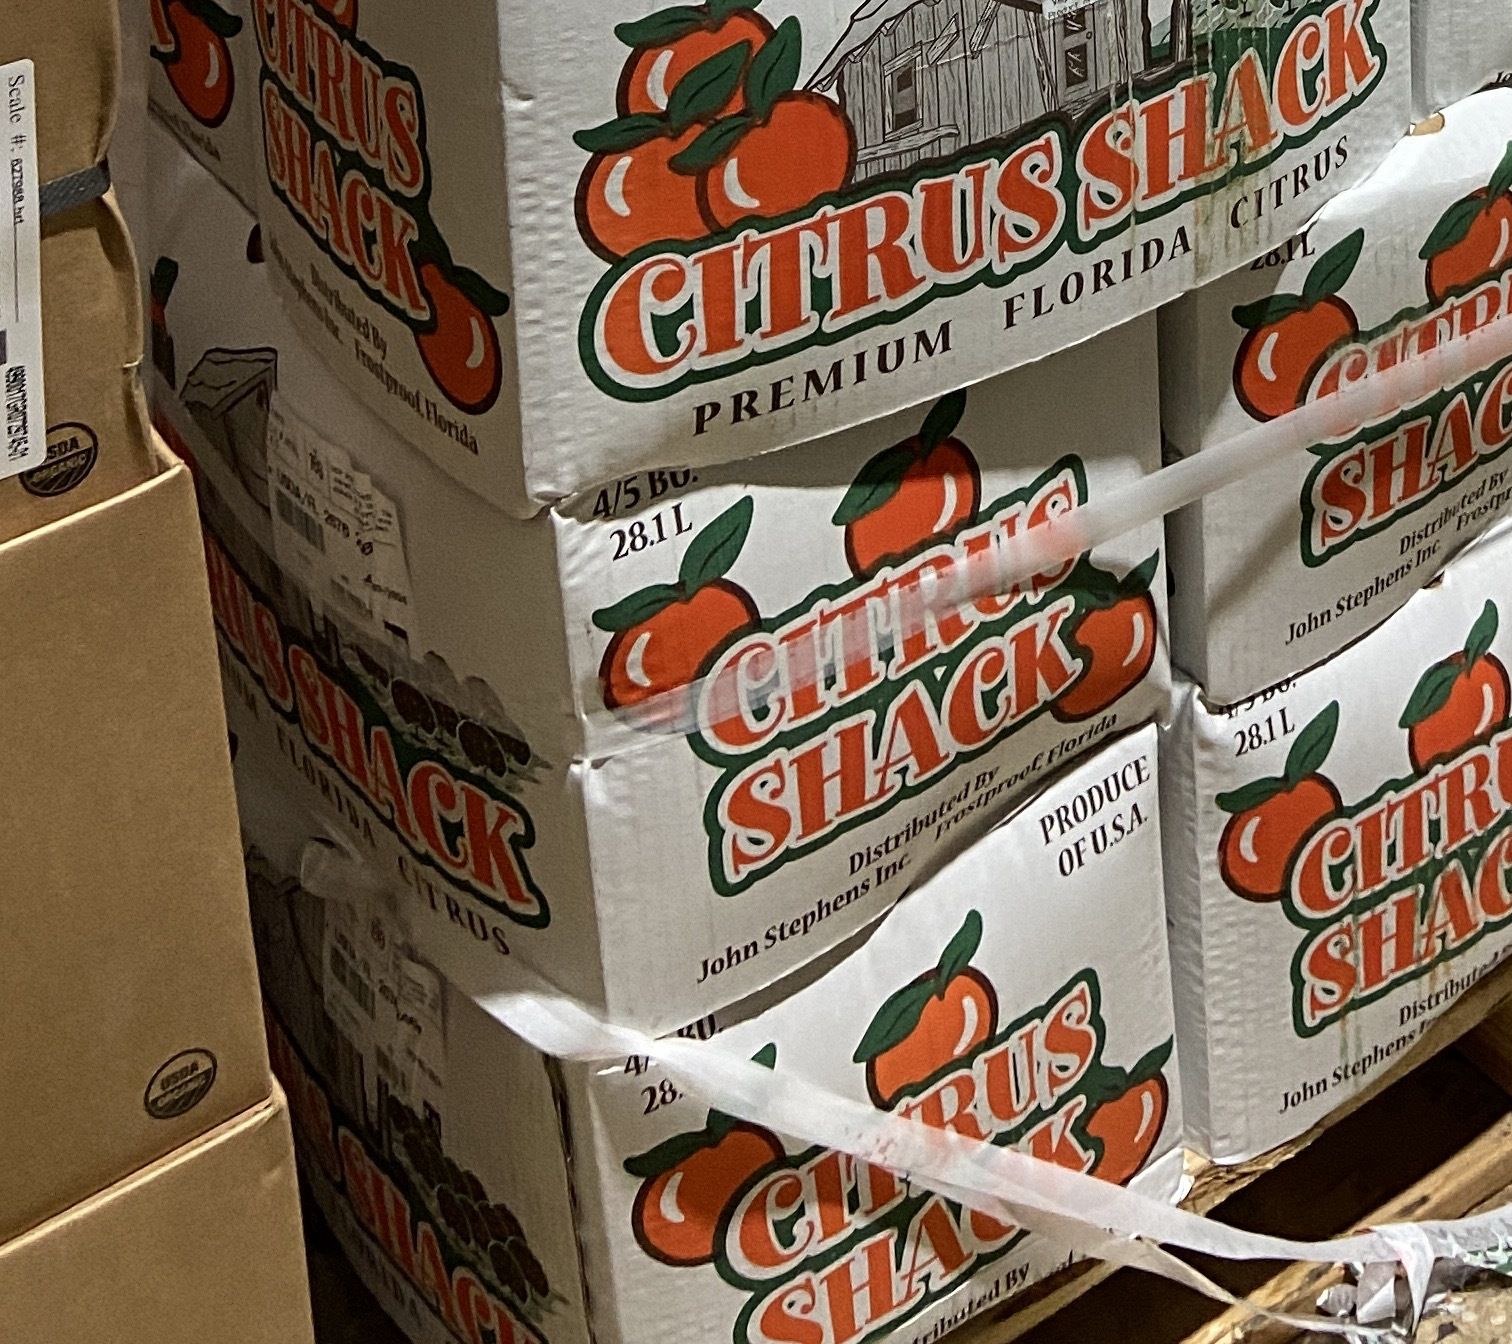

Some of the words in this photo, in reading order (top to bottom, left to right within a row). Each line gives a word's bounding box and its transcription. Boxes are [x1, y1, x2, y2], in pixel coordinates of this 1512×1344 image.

[264, 92, 429, 317] SHACK
[600, 161, 1064, 377] CITRUS
[693, 320, 953, 437] PREMIUM
[1002, 226, 1192, 331] FLORIDA
[1231, 136, 1351, 229] CITRUS
[609, 513, 665, 562] 28.1
[1284, 604, 1331, 646] John
[1334, 556, 1414, 618] Stephens
[290, 644, 533, 906] SHACK
[723, 608, 1084, 875] SHACK
[1233, 719, 1280, 760] 28.1
[848, 783, 970, 876] Distributed
[1039, 754, 1152, 845] PRODUCE
[1056, 836, 1089, 878] OF
[697, 941, 760, 984] John
[764, 874, 870, 949] Stephens
[1279, 1075, 1328, 1116] John
